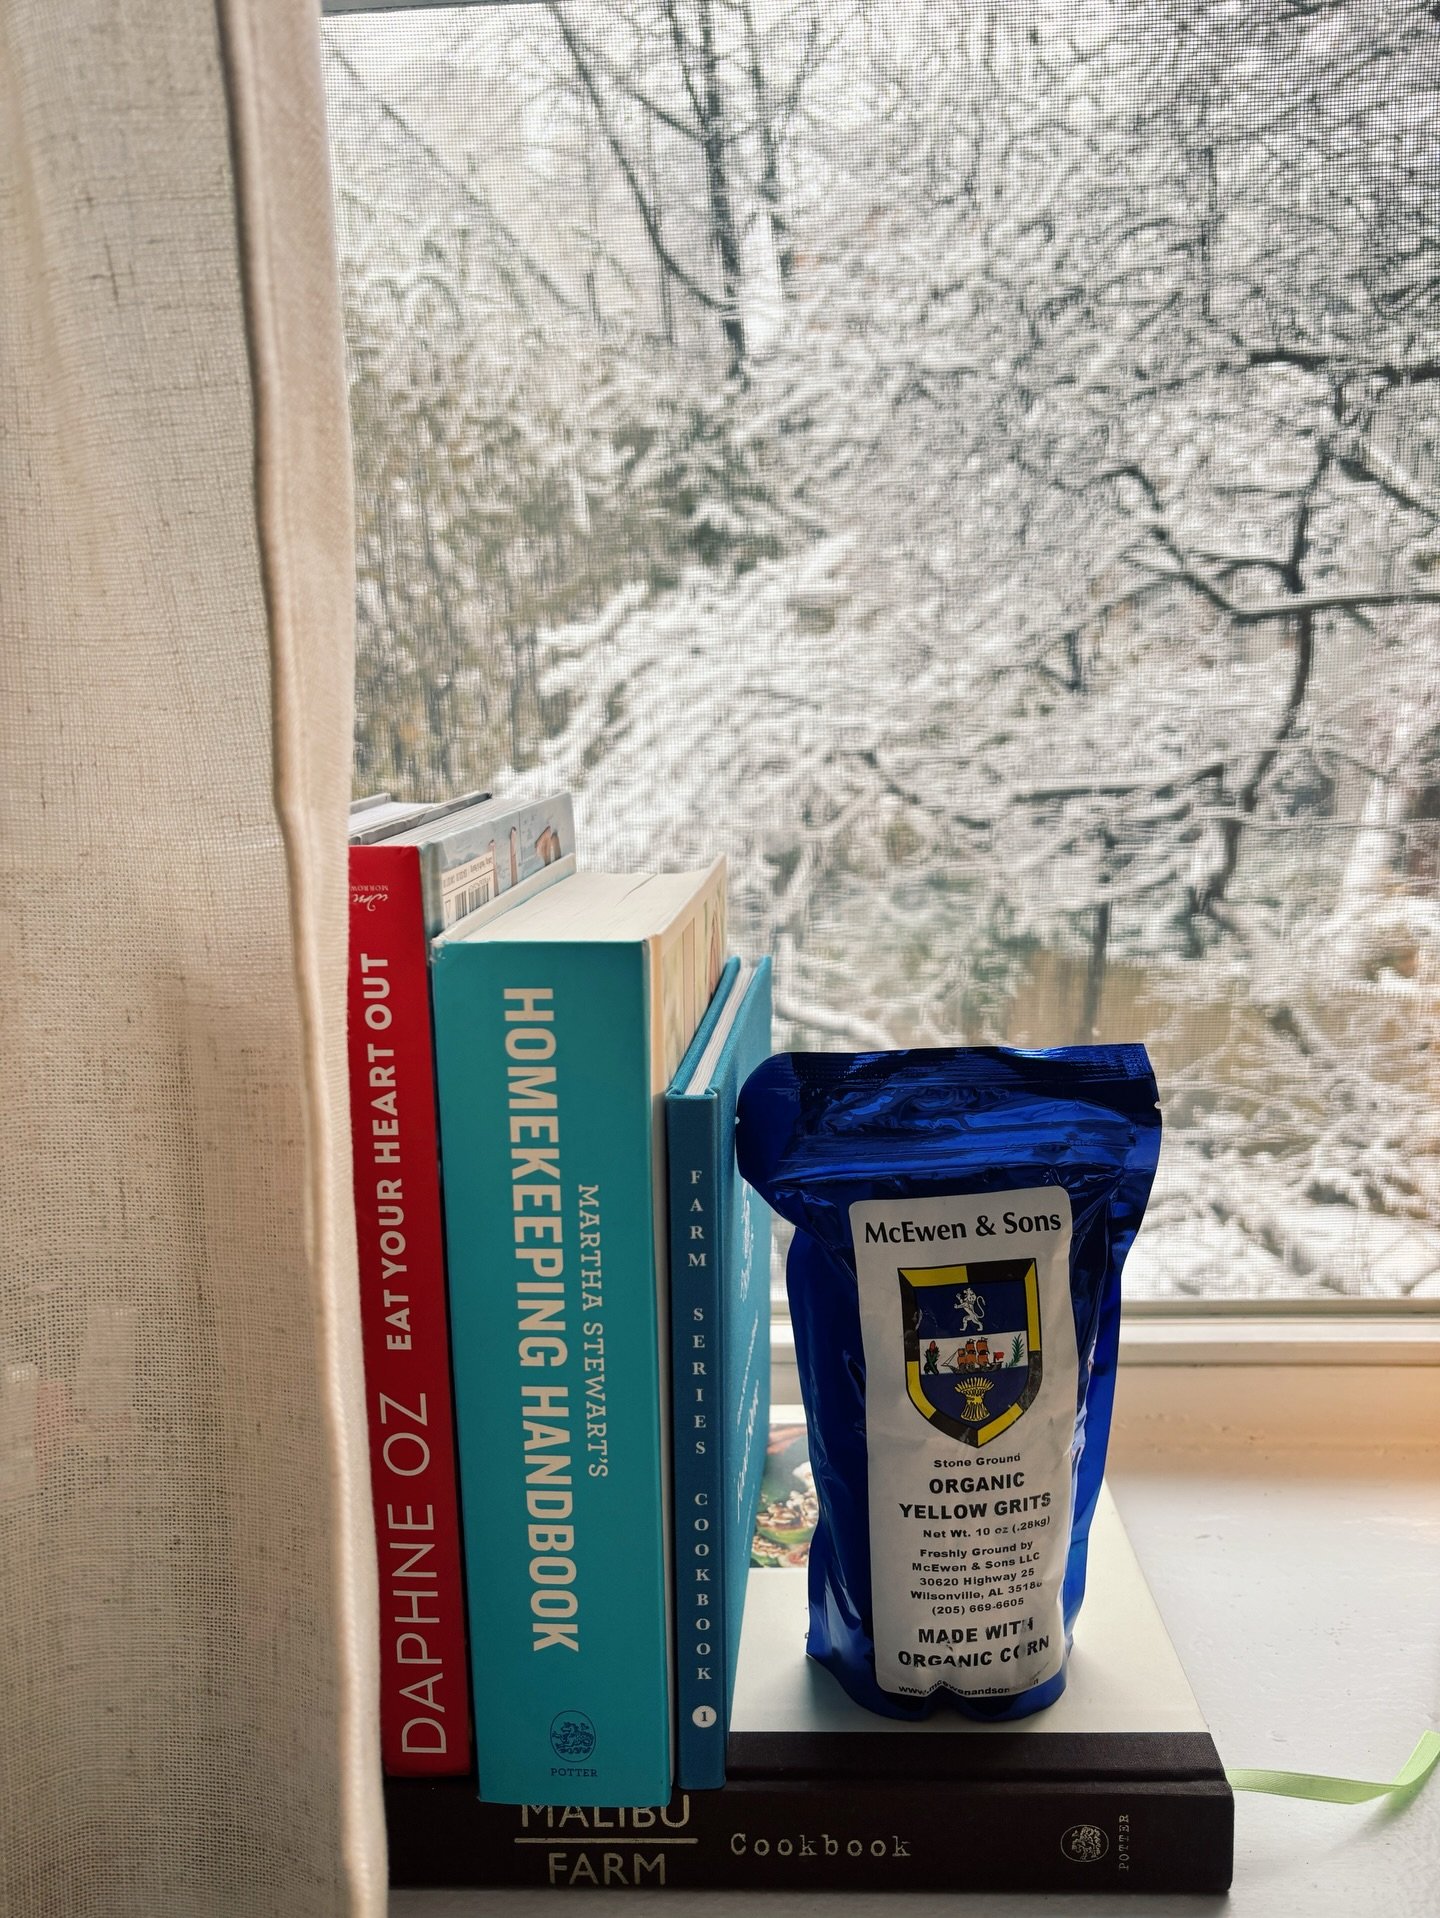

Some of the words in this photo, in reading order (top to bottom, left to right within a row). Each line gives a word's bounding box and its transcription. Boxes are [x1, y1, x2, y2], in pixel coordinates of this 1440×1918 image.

[360, 953, 393, 1031] OUT
[367, 1043, 401, 1164] HEART
[503, 987, 569, 1368] HOMEKEEPING
[377, 1178, 407, 1280] YOUR
[688, 1170, 707, 1267] FARM
[865, 1220, 967, 1244] McEwen
[975, 1214, 996, 1237] &
[1004, 1211, 1062, 1235] Sons
[577, 1184, 603, 1312] MARTHA
[384, 1289, 412, 1351] EAT
[692, 1307, 707, 1455] SERIES
[583, 1321, 609, 1478] STEWART'S
[379, 1392, 431, 1477] OZ
[933, 1459, 972, 1468] Stone
[975, 1452, 1021, 1466] Ground
[929, 1471, 1025, 1494] ORGANIC
[520, 1385, 580, 1653] HANDBOOK
[898, 1502, 988, 1520] YELLOW
[994, 1491, 1051, 1516] GRITS
[923, 1529, 946, 1538] Net
[950, 1529, 971, 1538] Wt.
[976, 1527, 990, 1537] 10
[994, 1526, 1009, 1534] oz
[1012, 1515, 1050, 1534] (.28kg)
[912, 1562, 967, 1572] McEwen
[971, 1562, 981, 1571] &
[985, 1558, 1016, 1570] Sons
[1019, 1551, 1040, 1564] LLC
[920, 1548, 968, 1559] Freshly
[971, 1543, 1017, 1556] Ground
[1020, 1540, 1033, 1551] by
[694, 1492, 712, 1680] COOKBOOK
[919, 1577, 959, 1586] 30620
[963, 1571, 1017, 1586] Highway
[1020, 1567, 1035, 1578] 25
[910, 1590, 984, 1600] Wilsonville,
[988, 1588, 1004, 1598] AL
[931, 1605, 966, 1616] (205)
[969, 1597, 1024, 1613] 669-6605
[386, 1503, 448, 1754] DAPHNE
[918, 1627, 978, 1644] MADE
[897, 1650, 993, 1668] ORGANIC
[701, 1710, 709, 1723] 1
[550, 1767, 598, 1778] POTTER
[521, 1794, 690, 1828] MALIBU
[730, 1831, 912, 1858] Cookbook
[1118, 1814, 1130, 1872] POTTER
[549, 1852, 666, 1885] FARM
